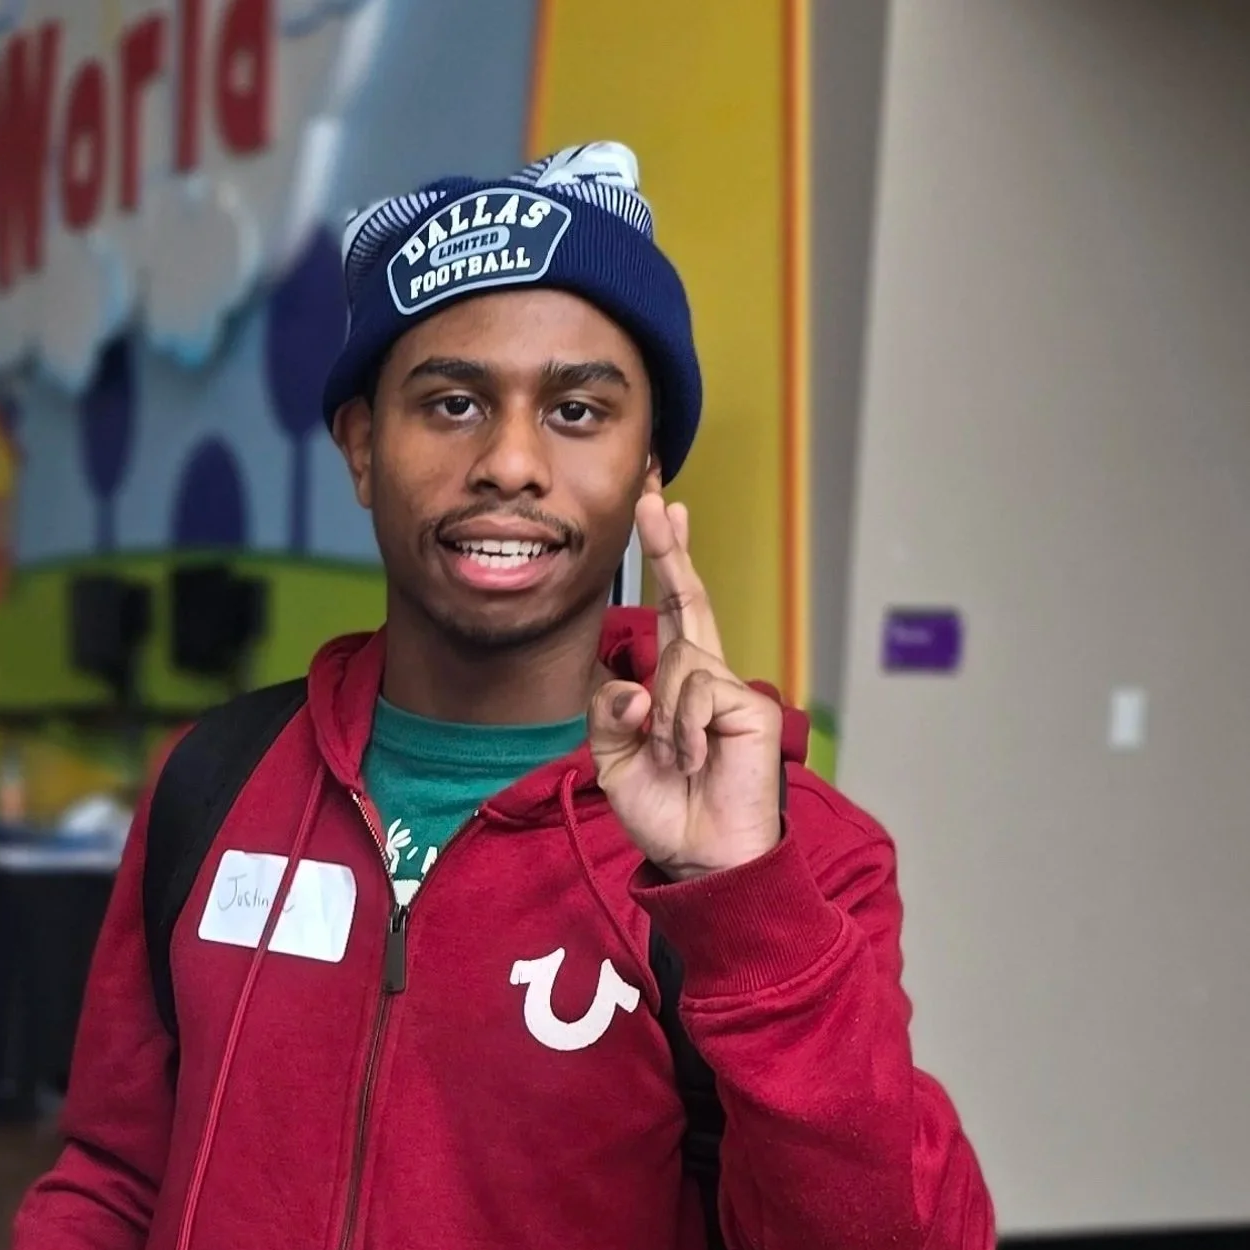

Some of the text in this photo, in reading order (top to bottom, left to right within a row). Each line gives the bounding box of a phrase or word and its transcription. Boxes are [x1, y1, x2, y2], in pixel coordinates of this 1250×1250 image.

[402, 194, 552, 266] DALLAS
[437, 230, 500, 261] LIMITED
[409, 246, 532, 300] FOOTBALL
